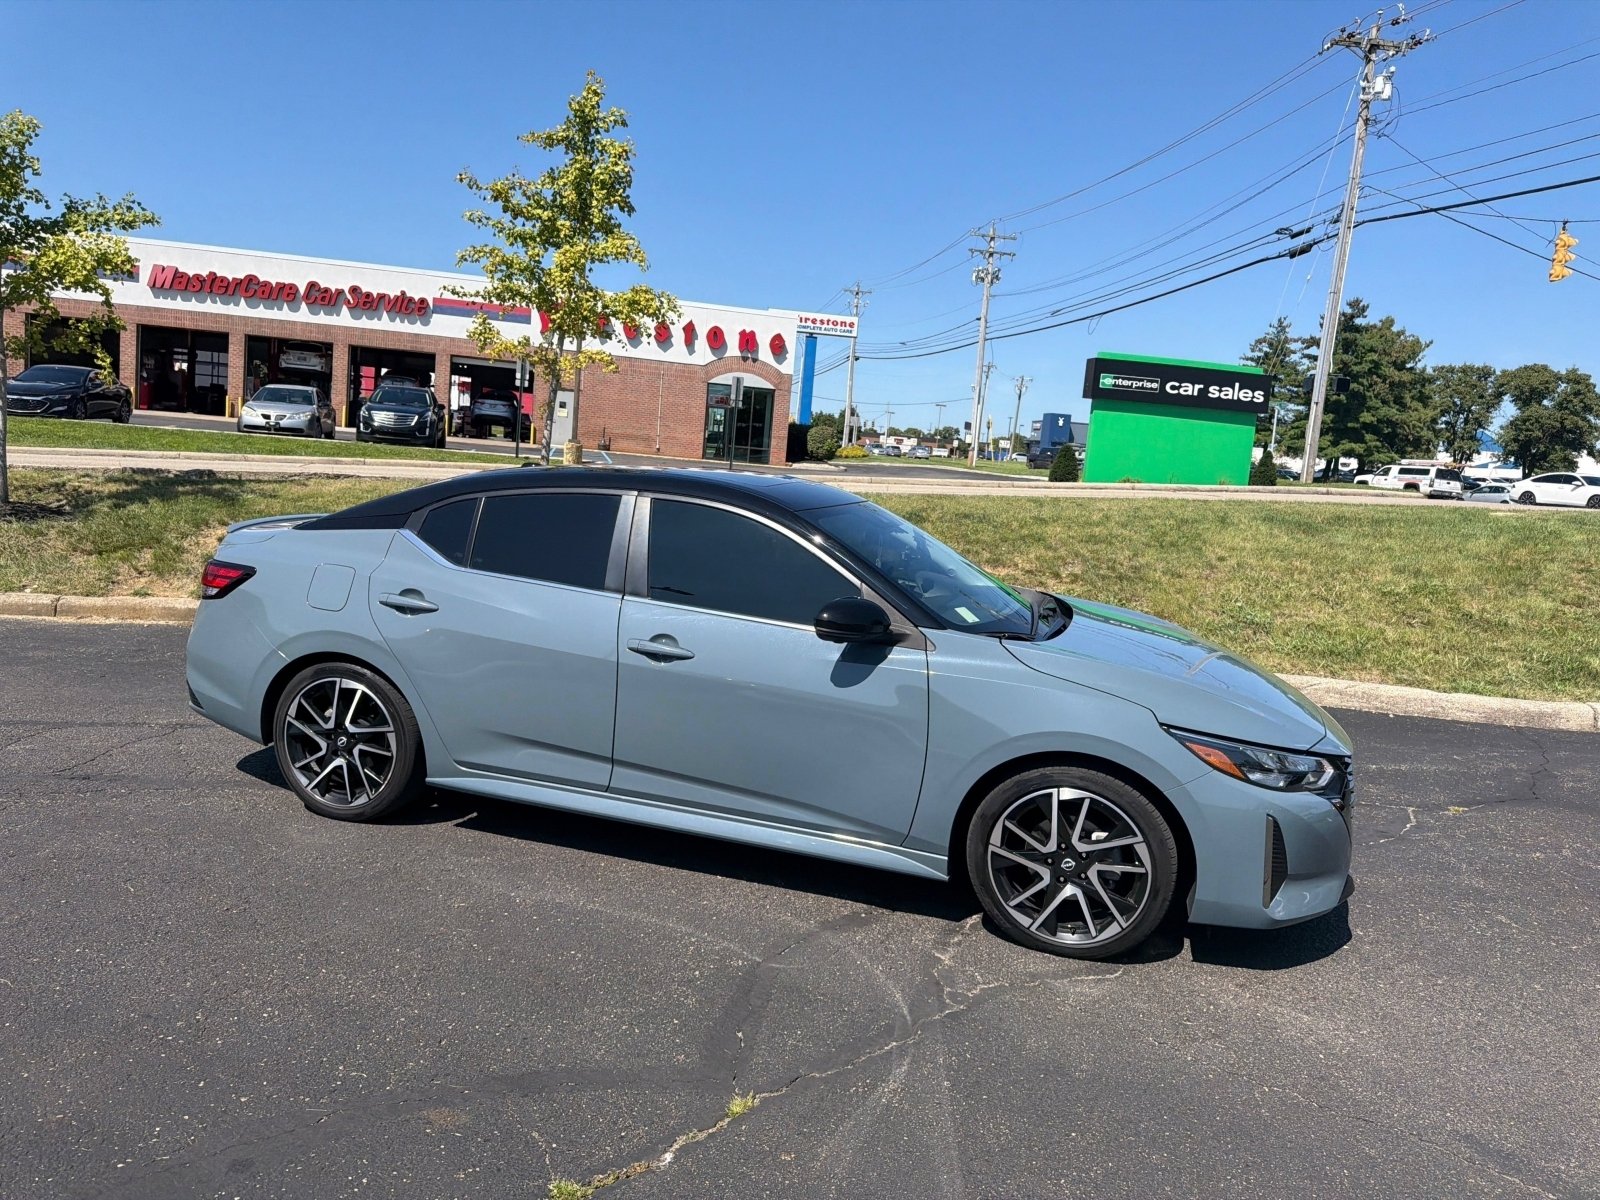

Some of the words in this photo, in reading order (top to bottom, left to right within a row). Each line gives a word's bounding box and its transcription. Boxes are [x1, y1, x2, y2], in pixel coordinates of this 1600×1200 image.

[147, 264, 299, 302] MasterCare
[302, 281, 345, 307] Car
[343, 285, 430, 316] Service
[798, 315, 855, 328] irestone
[1102, 377, 1158, 389] enterprise
[1165, 381, 1204, 396] car
[1207, 382, 1265, 403] sales
